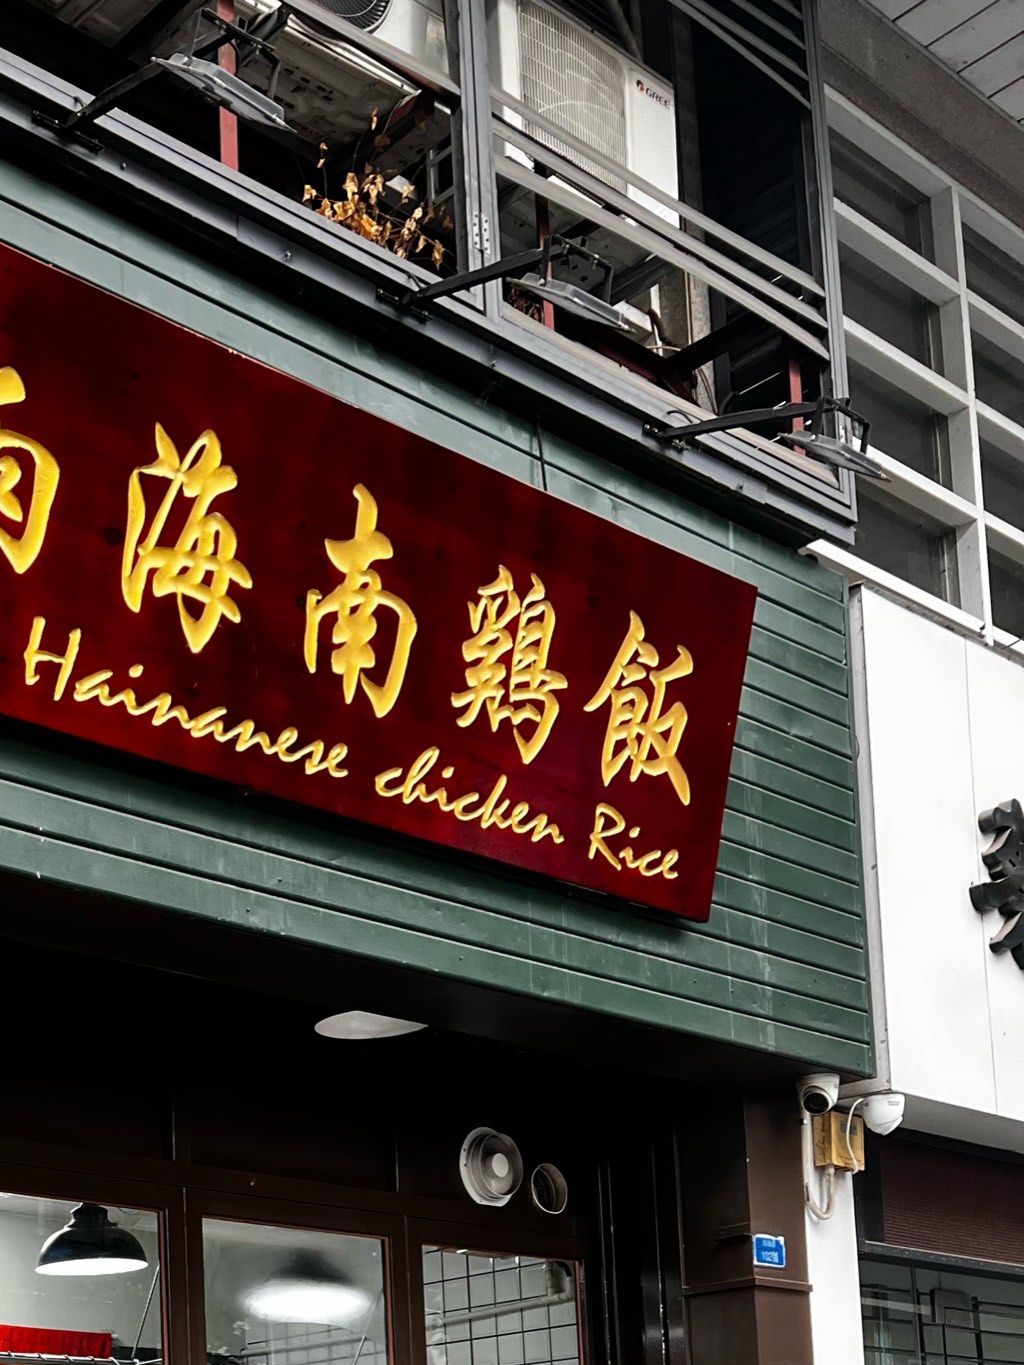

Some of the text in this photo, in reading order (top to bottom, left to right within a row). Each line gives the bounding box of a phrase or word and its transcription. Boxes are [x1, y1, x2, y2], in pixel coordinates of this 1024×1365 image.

[646, 88, 672, 109] GREE
[23, 617, 349, 778] Hainanese
[374, 747, 564, 845] chicken
[588, 802, 679, 880] Rice
